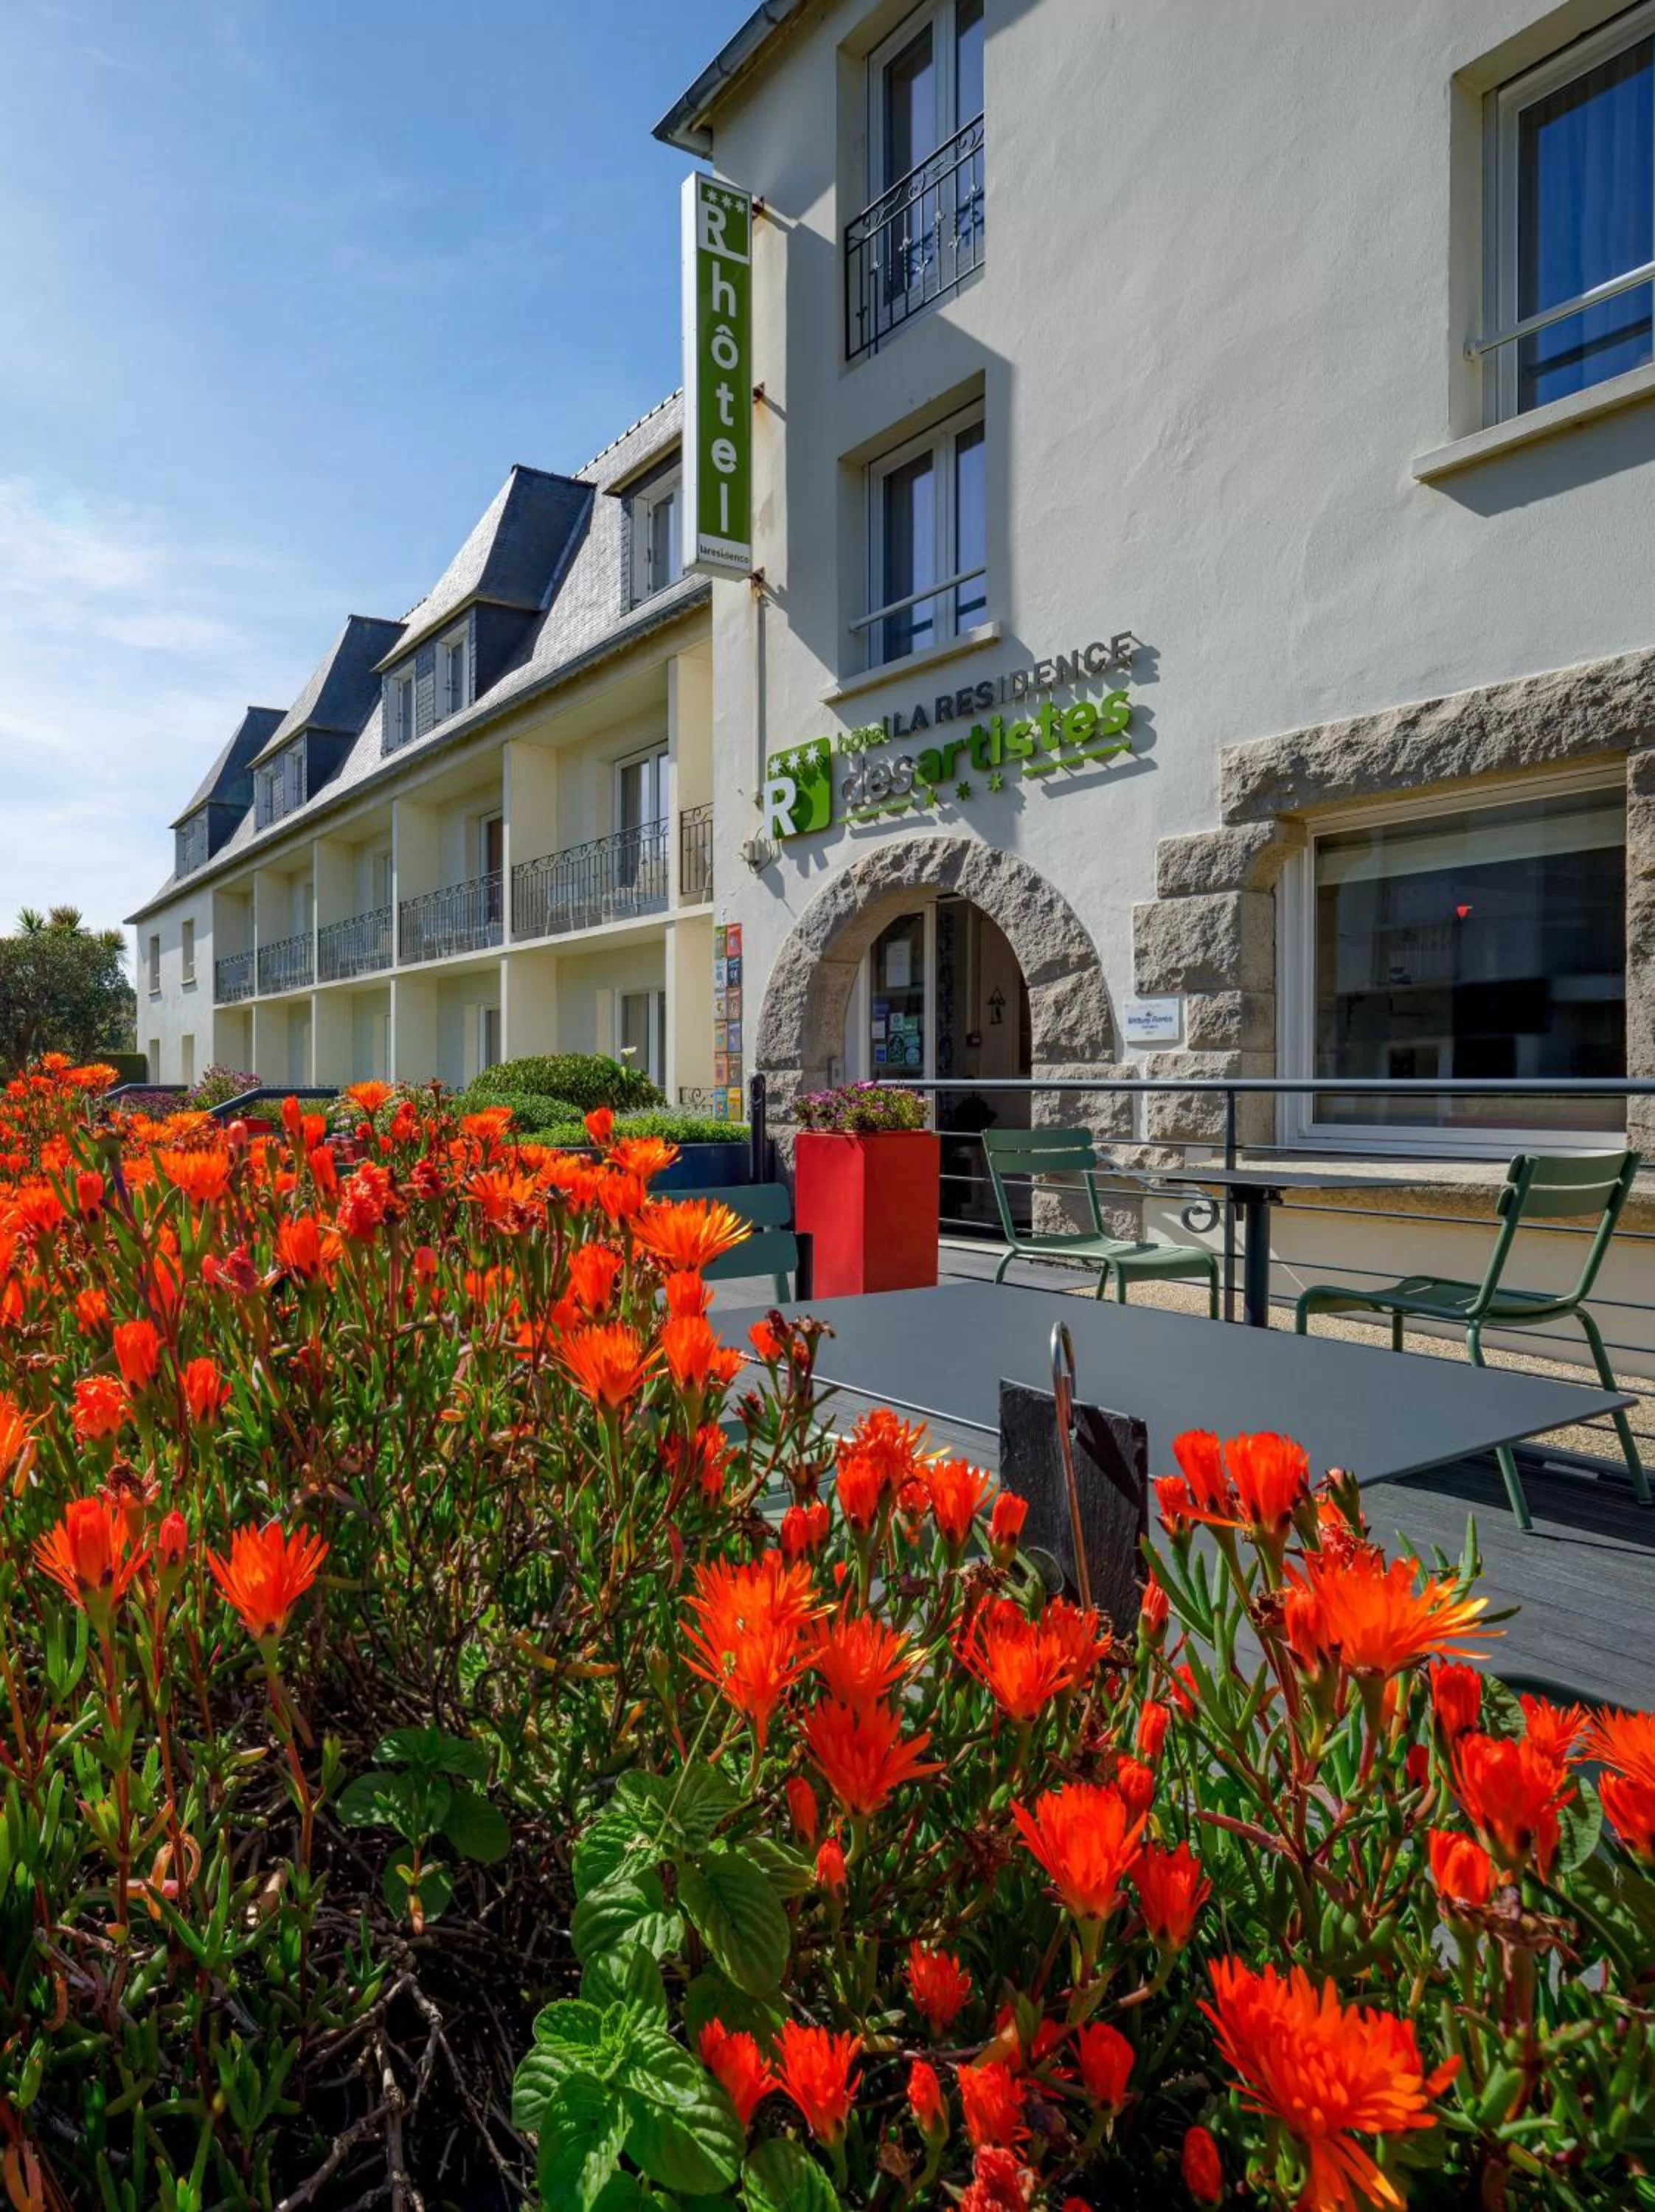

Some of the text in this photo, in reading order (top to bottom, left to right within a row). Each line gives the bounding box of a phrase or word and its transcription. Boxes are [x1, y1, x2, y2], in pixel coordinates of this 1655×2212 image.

[699, 201, 727, 251] R
[710, 260, 739, 533] hôtel
[763, 776, 798, 841] R
